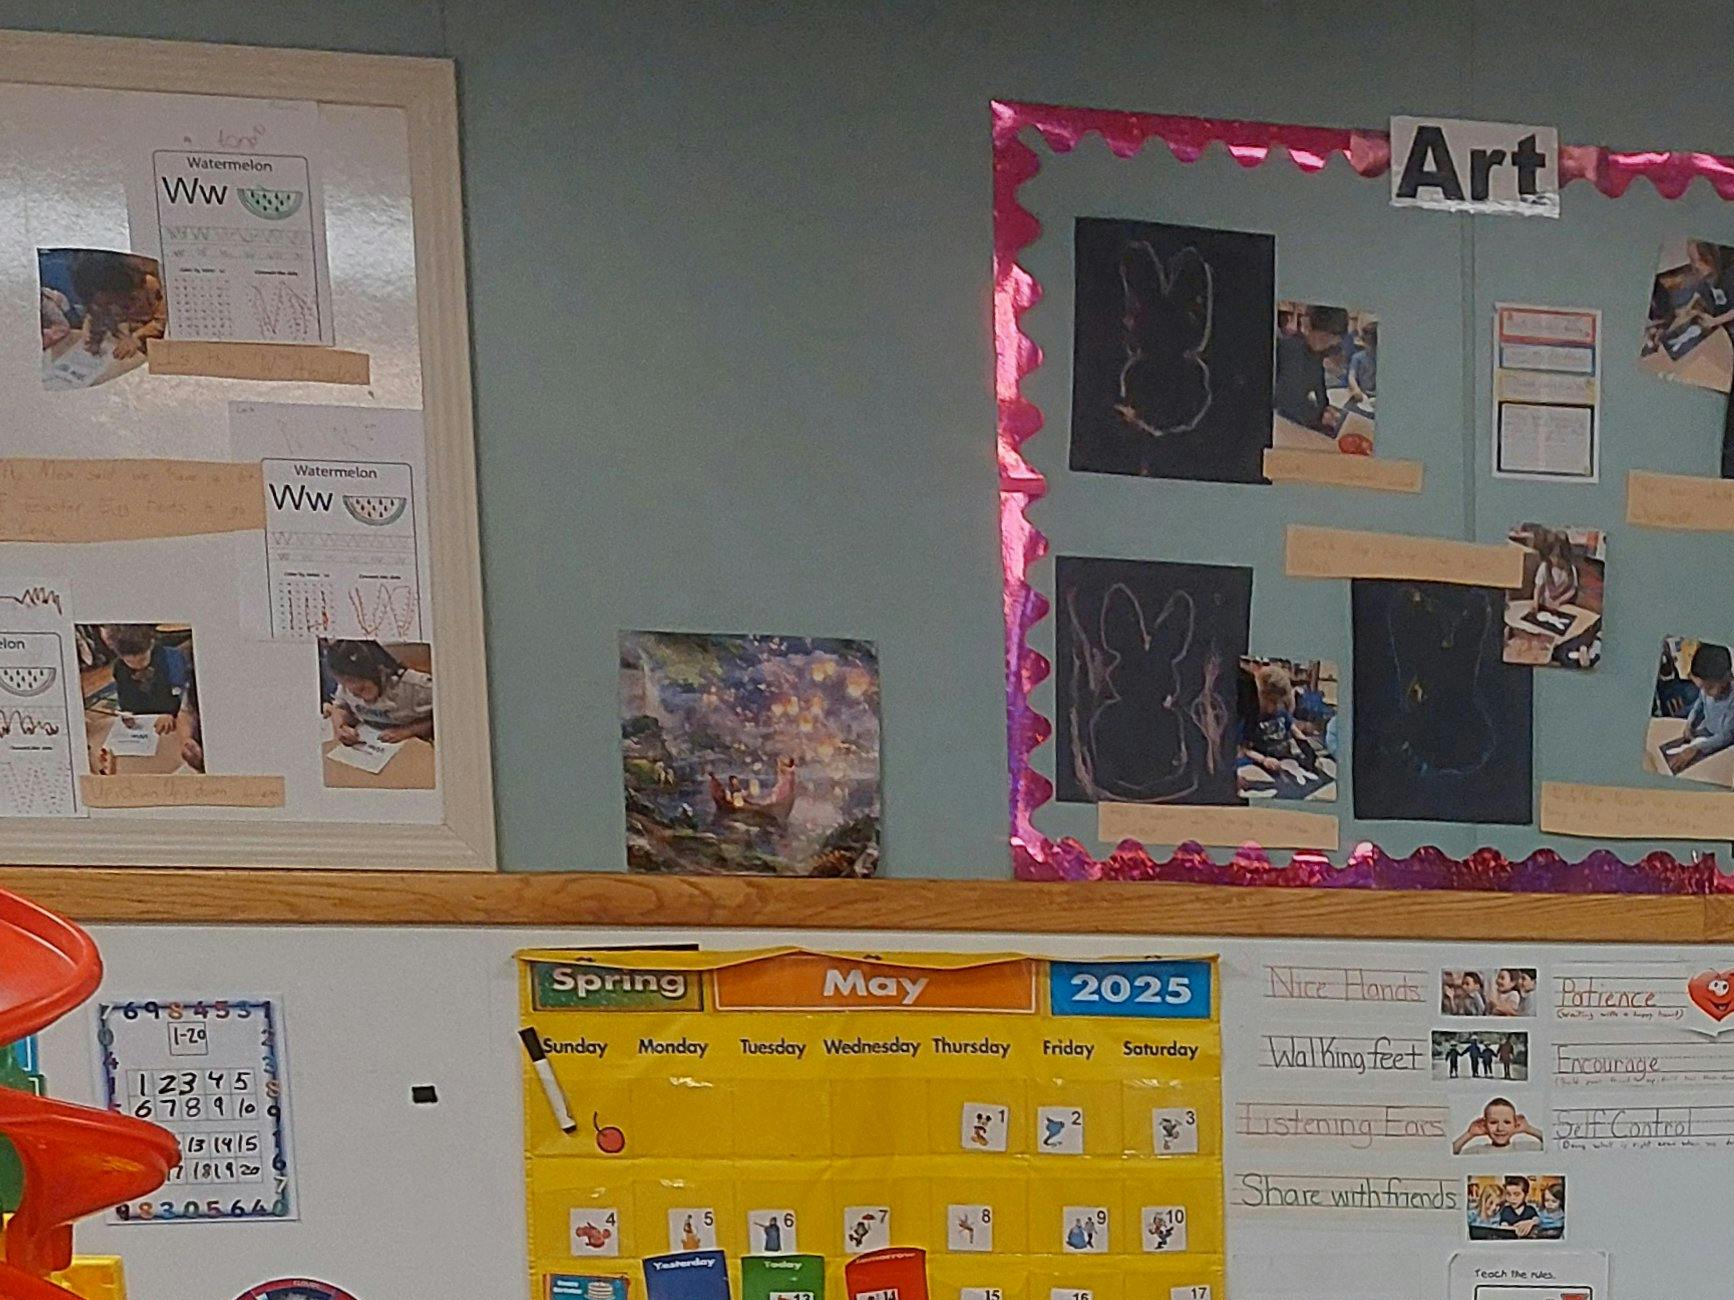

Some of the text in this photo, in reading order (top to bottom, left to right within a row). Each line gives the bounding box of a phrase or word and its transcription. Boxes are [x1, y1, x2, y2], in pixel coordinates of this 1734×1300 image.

[187, 156, 273, 172] Watermelon
[1396, 125, 1546, 201] Art
[294, 463, 378, 480] Watermelon
[269, 483, 334, 512] Ww
[551, 967, 687, 998] Spring
[823, 968, 929, 1005] May
[1070, 974, 1193, 1005] 2025
[1271, 966, 1422, 1001] Nice Hands
[1561, 977, 1657, 1008] Patience
[123, 1002, 138, 1020] 6
[145, 1002, 159, 1019] 9
[168, 1003, 184, 1020] 8
[194, 1001, 209, 1019] 4
[214, 1001, 230, 1019] 5
[173, 1027, 207, 1046] 1-20
[543, 1036, 1199, 1062] Sunday Monday Tuesday Wednesday Thursday Friday Saturday
[1367, 1036, 1424, 1071] feet
[1556, 1044, 1659, 1081] Encourage
[140, 1070, 251, 1097] 1 2 3 4 5
[265, 1079, 281, 1098] 8
[135, 1097, 256, 1118] 6 7 8 9 10
[267, 1105, 281, 1124] 9
[998, 1110, 1006, 1124] 1
[1071, 1111, 1082, 1126] 2
[1185, 1110, 1196, 1126] 3
[1244, 1103, 1446, 1149] Listening Ears
[1612, 1107, 1692, 1138] Control
[188, 1134, 259, 1153] 13 14 15
[193, 1163, 211, 1180] 18
[214, 1160, 235, 1180] 19
[240, 1163, 261, 1176] 20
[272, 1153, 287, 1171] 6
[1241, 1173, 1458, 1210] Share with friends
[138, 1202, 154, 1220] 8
[184, 1201, 200, 1218] 0
[206, 1200, 222, 1218] 5
[231, 1199, 245, 1217] 6
[605, 1212, 616, 1226] 4
[704, 1210, 714, 1226] 5
[878, 1209, 889, 1224] 7
[981, 1209, 991, 1224] 8
[1096, 1210, 1107, 1225] 9
[1167, 1209, 1184, 1225] 10
[784, 1213, 795, 1228] 6
[1474, 1269, 1556, 1280] Teach the rules.
[1191, 1287, 1207, 1300] 17
